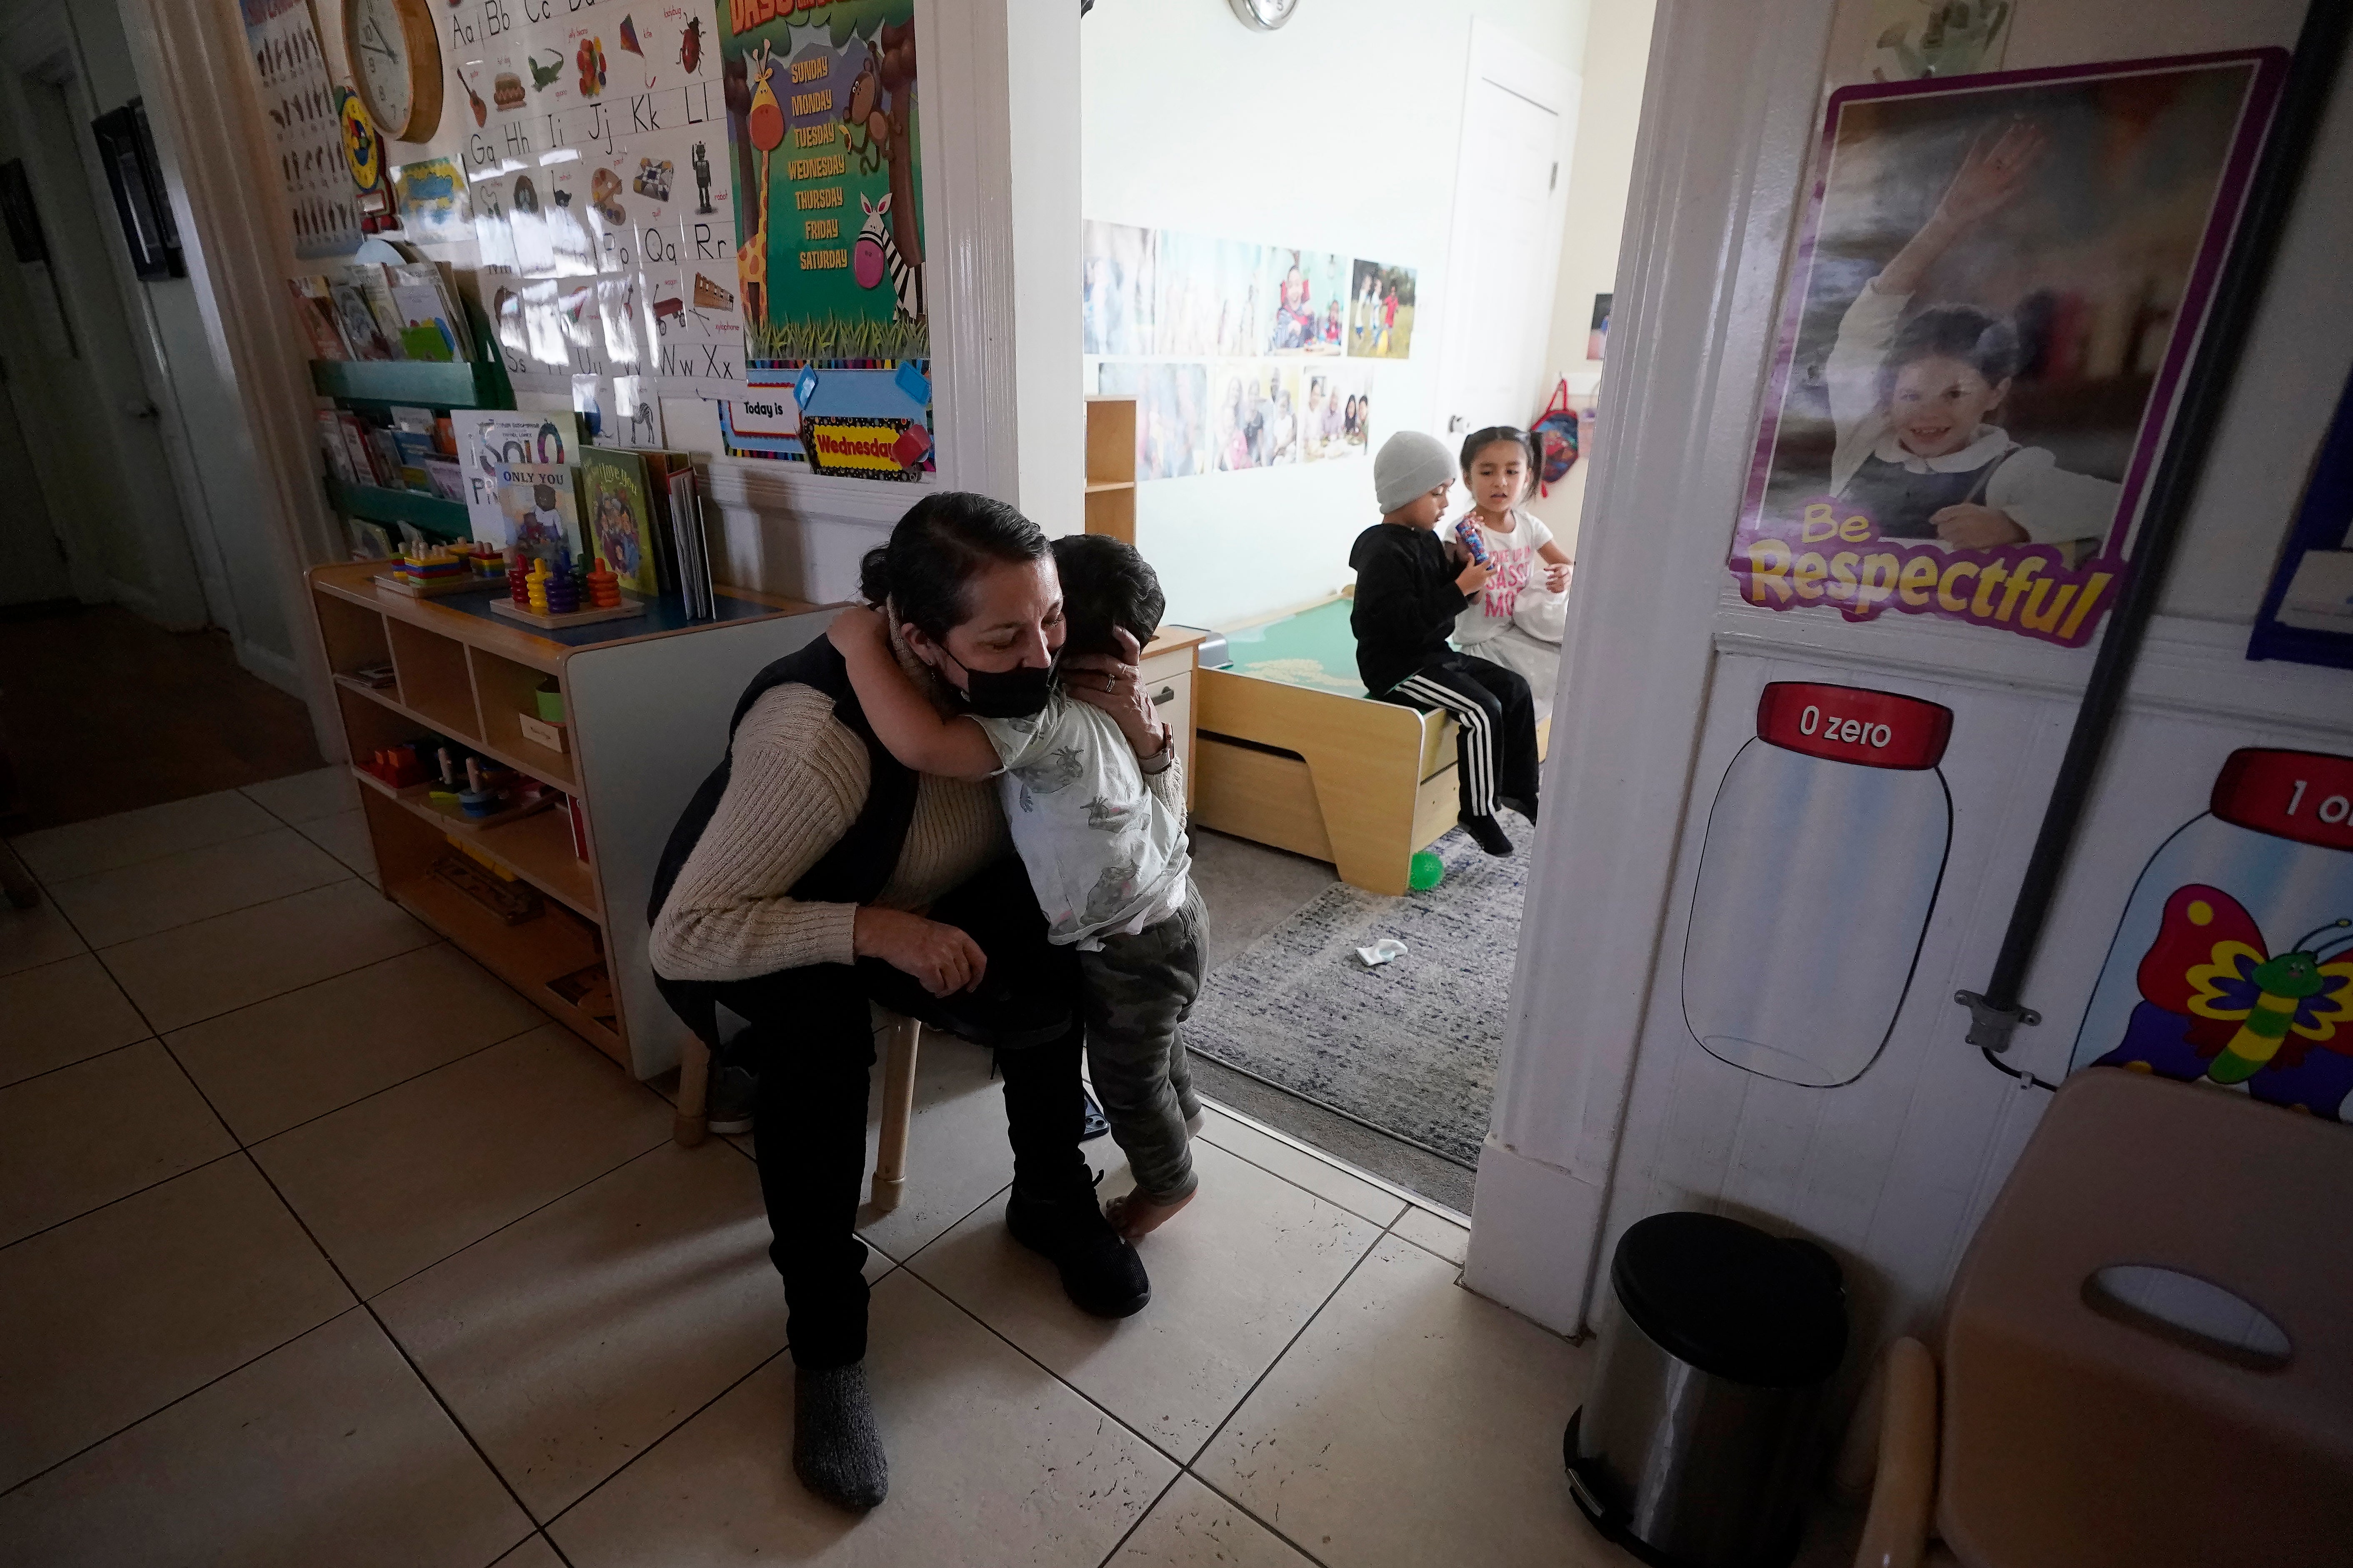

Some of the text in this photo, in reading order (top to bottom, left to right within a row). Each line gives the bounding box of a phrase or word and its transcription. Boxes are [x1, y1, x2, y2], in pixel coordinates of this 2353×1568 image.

[454, 14, 475, 49] Aa
[485, 0, 510, 35] Bb
[792, 56, 829, 84] SUNDAY
[631, 92, 660, 133] Kk
[685, 82, 709, 125] Ll
[792, 89, 833, 117] MONDAY
[504, 121, 530, 156] Hh
[548, 113, 564, 148] Ii
[588, 102, 613, 155] Jj
[793, 122, 835, 149] TUESDAY
[788, 154, 846, 181] WEDNESDAY
[795, 187, 843, 210] THURSDAY
[645, 228, 677, 266] Qq
[694, 223, 727, 260] Rr
[805, 219, 838, 240] FRIDAY
[799, 249, 848, 271] SATURDAY
[703, 345, 733, 380] Xx
[744, 401, 783, 418] Today is
[503, 471, 565, 485] ONLY YOU
[1801, 503, 1872, 544] Be
[1748, 539, 2115, 640] Respectful
[1800, 705, 1892, 748] 0 zero
[2287, 779, 2353, 827] 1 o
